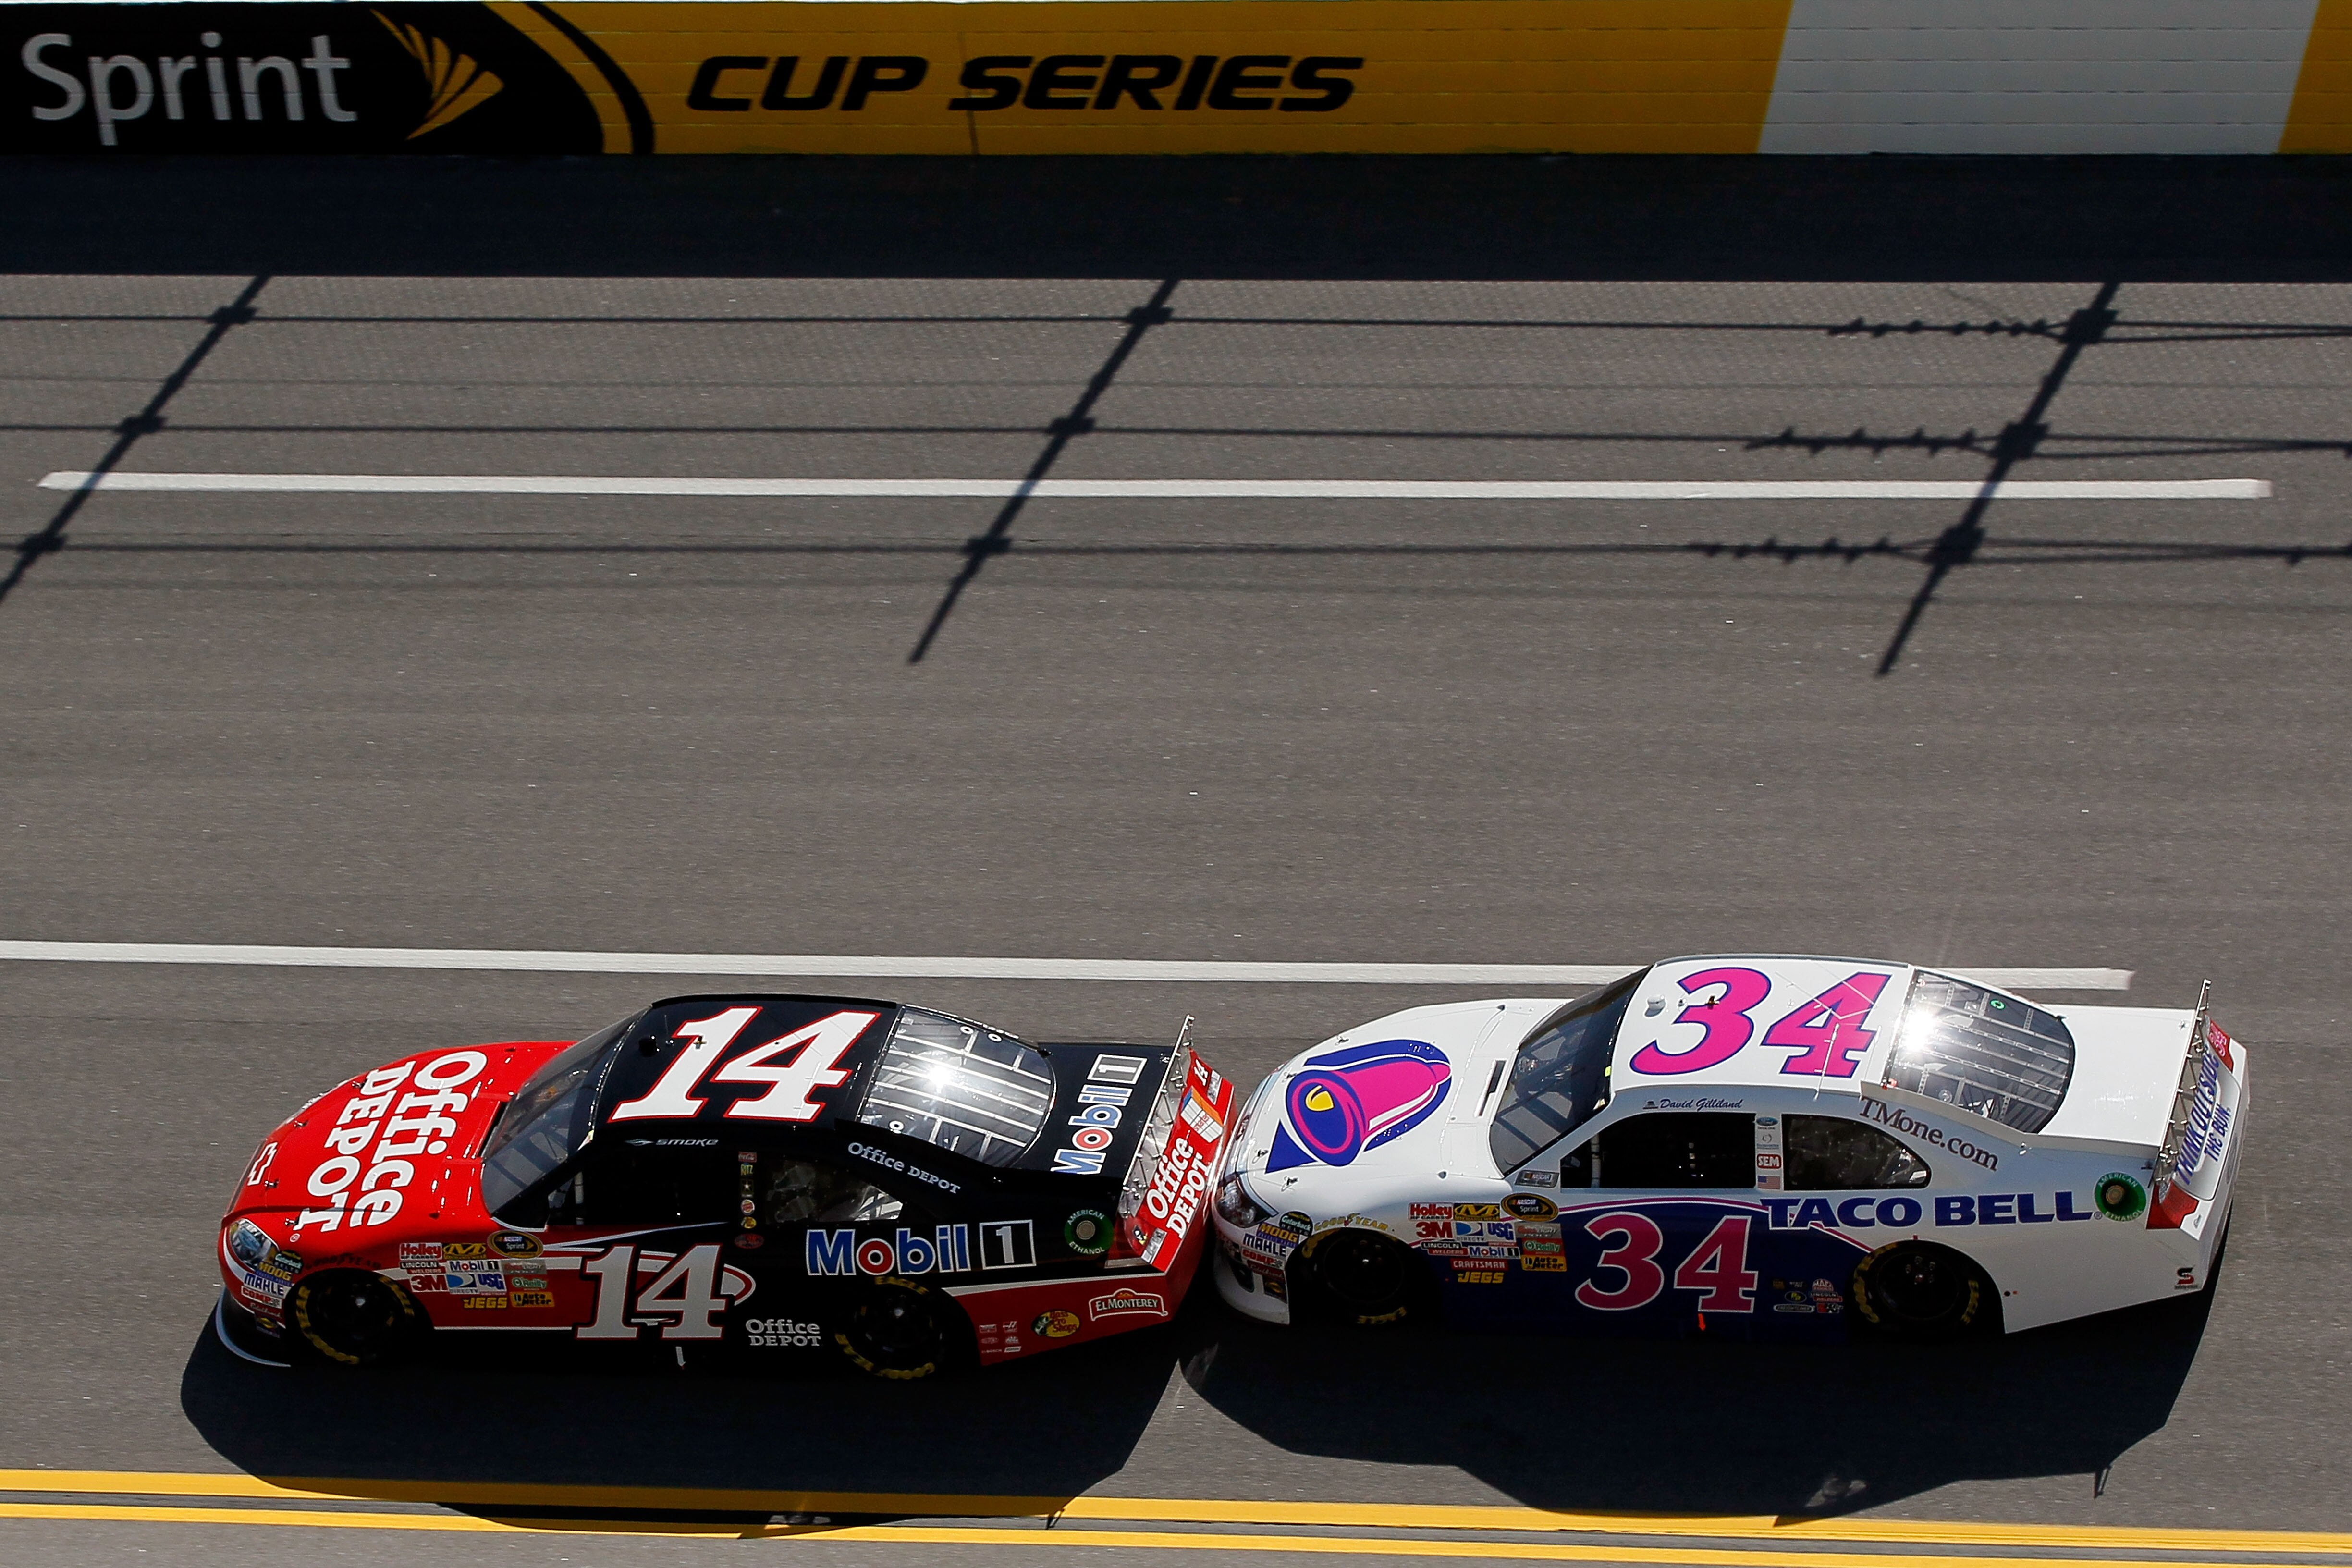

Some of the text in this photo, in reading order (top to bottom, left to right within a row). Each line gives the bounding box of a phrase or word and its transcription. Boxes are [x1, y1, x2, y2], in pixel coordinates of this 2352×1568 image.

[21, 32, 358, 146] Sprint
[686, 54, 1365, 112] CUP SERIES
[1629, 966, 1893, 1078] 34
[608, 1006, 882, 1123] 14
[1194, 1059, 1208, 1086] 14
[2190, 1044, 2219, 1132] OUTSIDE
[1660, 1098, 1743, 1112] David Gilliland
[349, 1051, 487, 1227] Office
[1050, 1084, 1133, 1175] Mobil
[1859, 1096, 1998, 1172] TMone.com
[293, 1060, 416, 1232] DEPOT
[2176, 1123, 2205, 1185] THINK
[2204, 1132, 2223, 1162] THE
[848, 1142, 961, 1194] Office DEPOT
[1758, 1155, 1780, 1167] SEM
[1146, 1137, 1194, 1219] Office
[2098, 1173, 2139, 1188] AMERICAN
[1166, 1152, 1213, 1239] DEPOT
[1067, 1209, 1105, 1225] AMERICAN
[1410, 1204, 1452, 1220] Holley
[1519, 1205, 1539, 1213] Sprint
[1759, 1191, 2094, 1228] TACO BELL
[2106, 1209, 2144, 1221] ETHANOL
[1314, 1213, 1388, 1231] GOODYEAR
[1416, 1221, 1453, 1238] 3M
[1487, 1222, 1514, 1241] USG
[1260, 1224, 1298, 1243] MOOG
[401, 1243, 441, 1258] Holley
[806, 1224, 971, 1276] Mobil
[1069, 1241, 1105, 1254] ETHANOL
[1243, 1234, 1287, 1257] MAHLE
[1470, 1247, 1505, 1256] Mobil
[450, 1260, 484, 1272] Mobil
[1243, 1250, 1274, 1264] COMP
[1453, 1260, 1506, 1269] CRAFTSMAN
[1574, 1211, 1759, 1314] 34
[244, 1274, 285, 1297] MAHLE
[411, 1274, 447, 1291] 3M
[477, 1273, 504, 1291] USG
[1458, 1272, 1504, 1284] JEGS
[576, 1244, 727, 1339] 14
[463, 1297, 508, 1309] JEGS
[745, 1318, 821, 1334] Office
[748, 1335, 822, 1346] DEPOT
